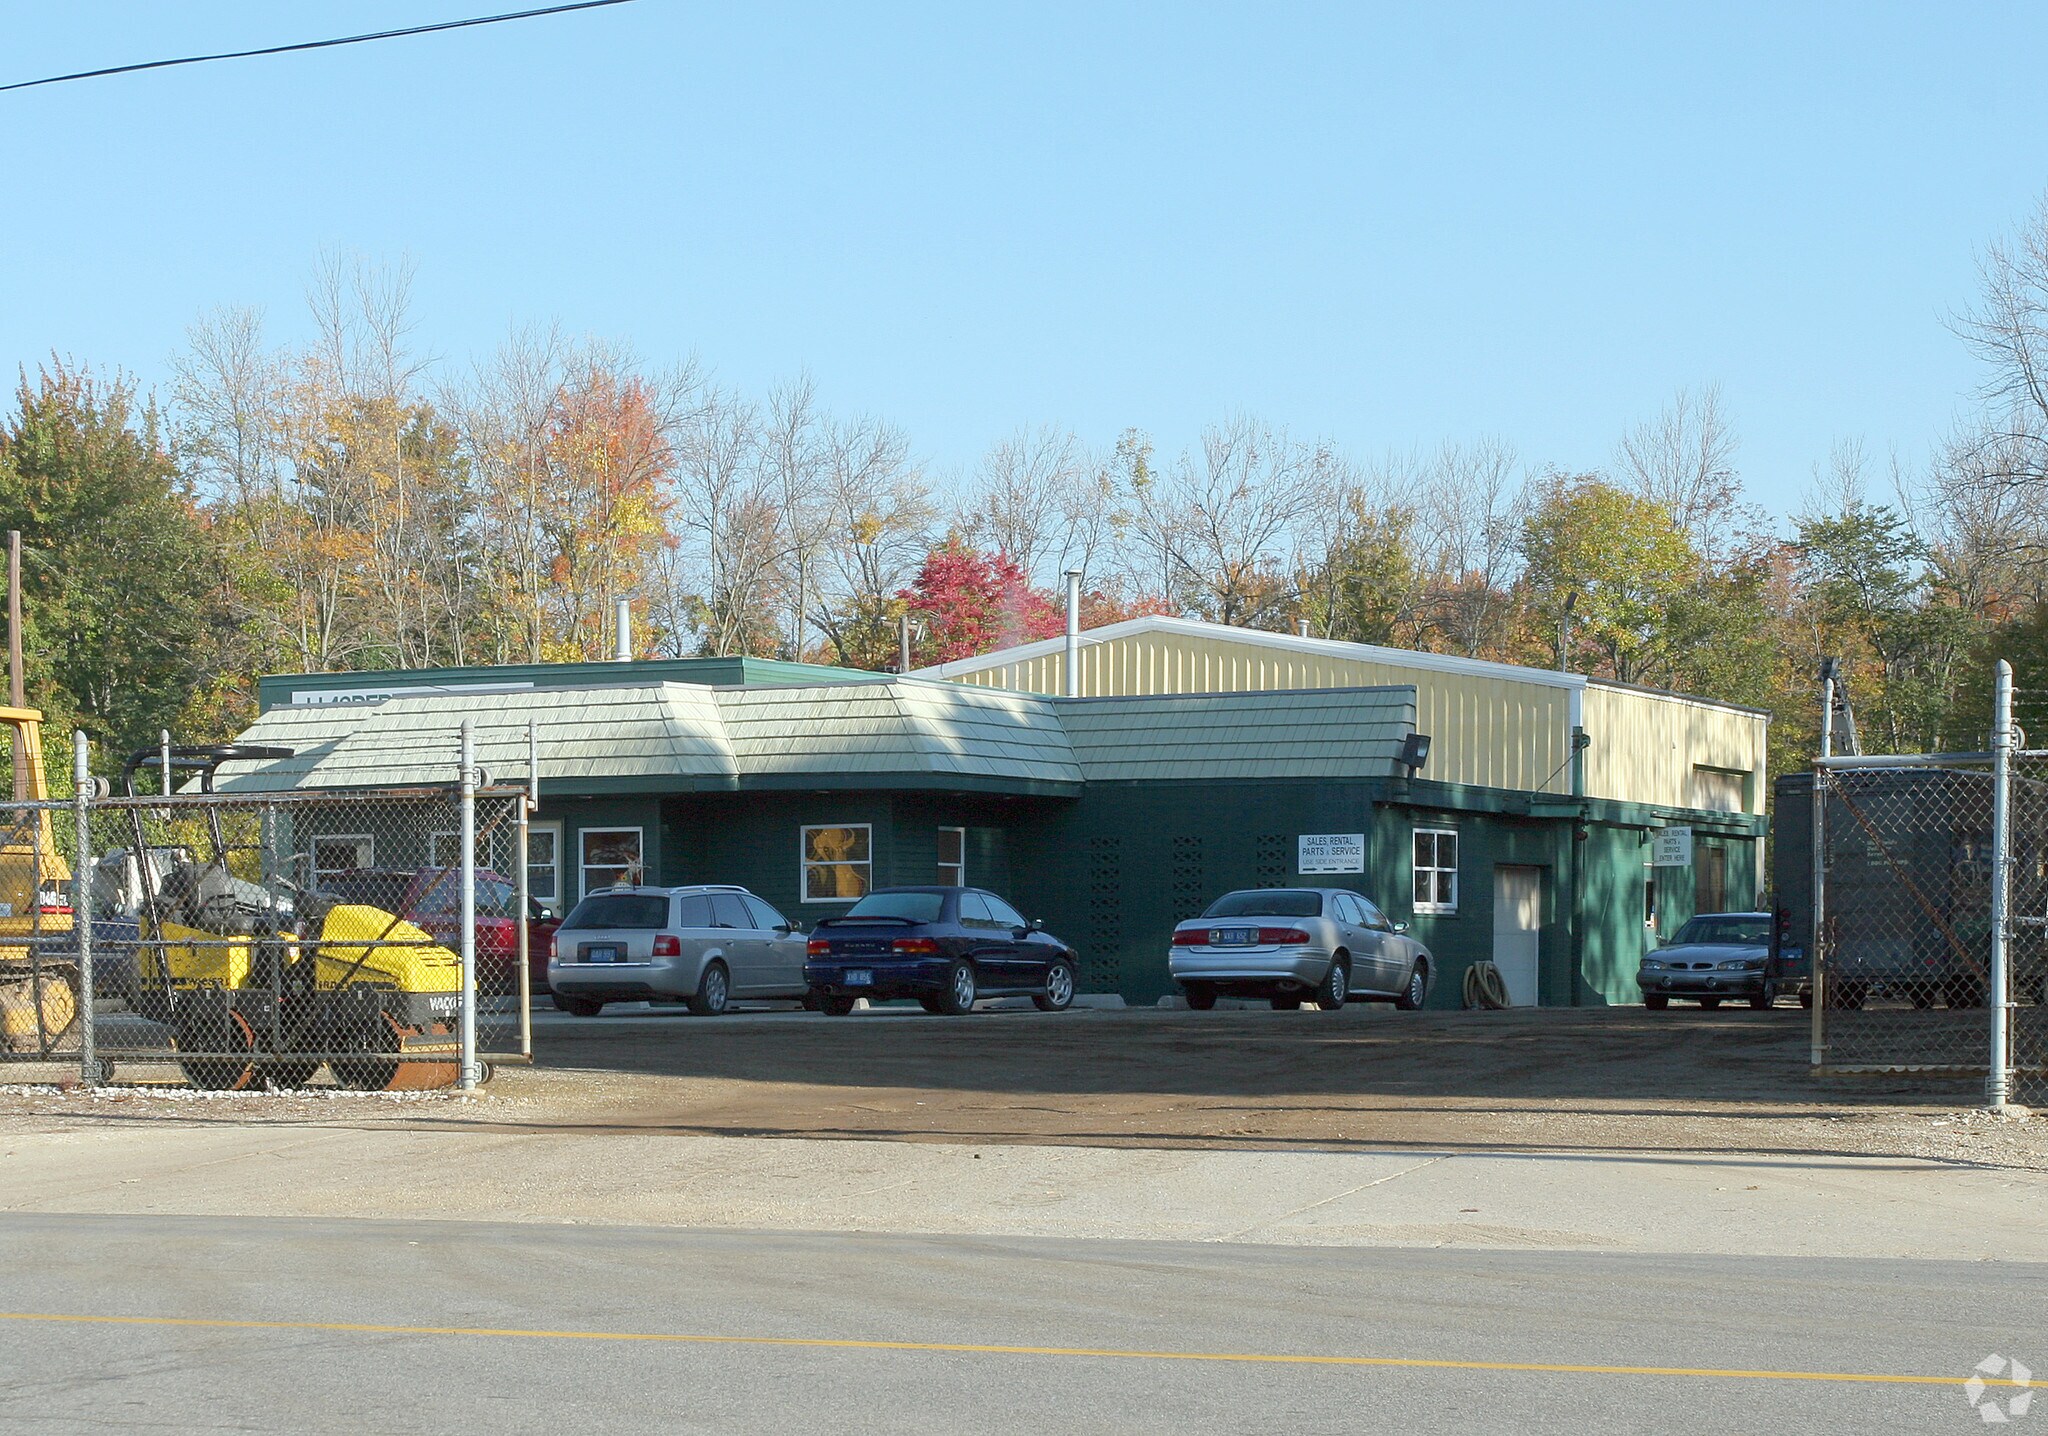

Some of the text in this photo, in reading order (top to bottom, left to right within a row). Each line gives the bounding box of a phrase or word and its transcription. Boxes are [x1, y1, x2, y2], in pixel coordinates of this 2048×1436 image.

[1302, 847, 1325, 856] PARTS
[1331, 846, 1361, 856] SERVICE
[429, 996, 464, 1011] WACKE
